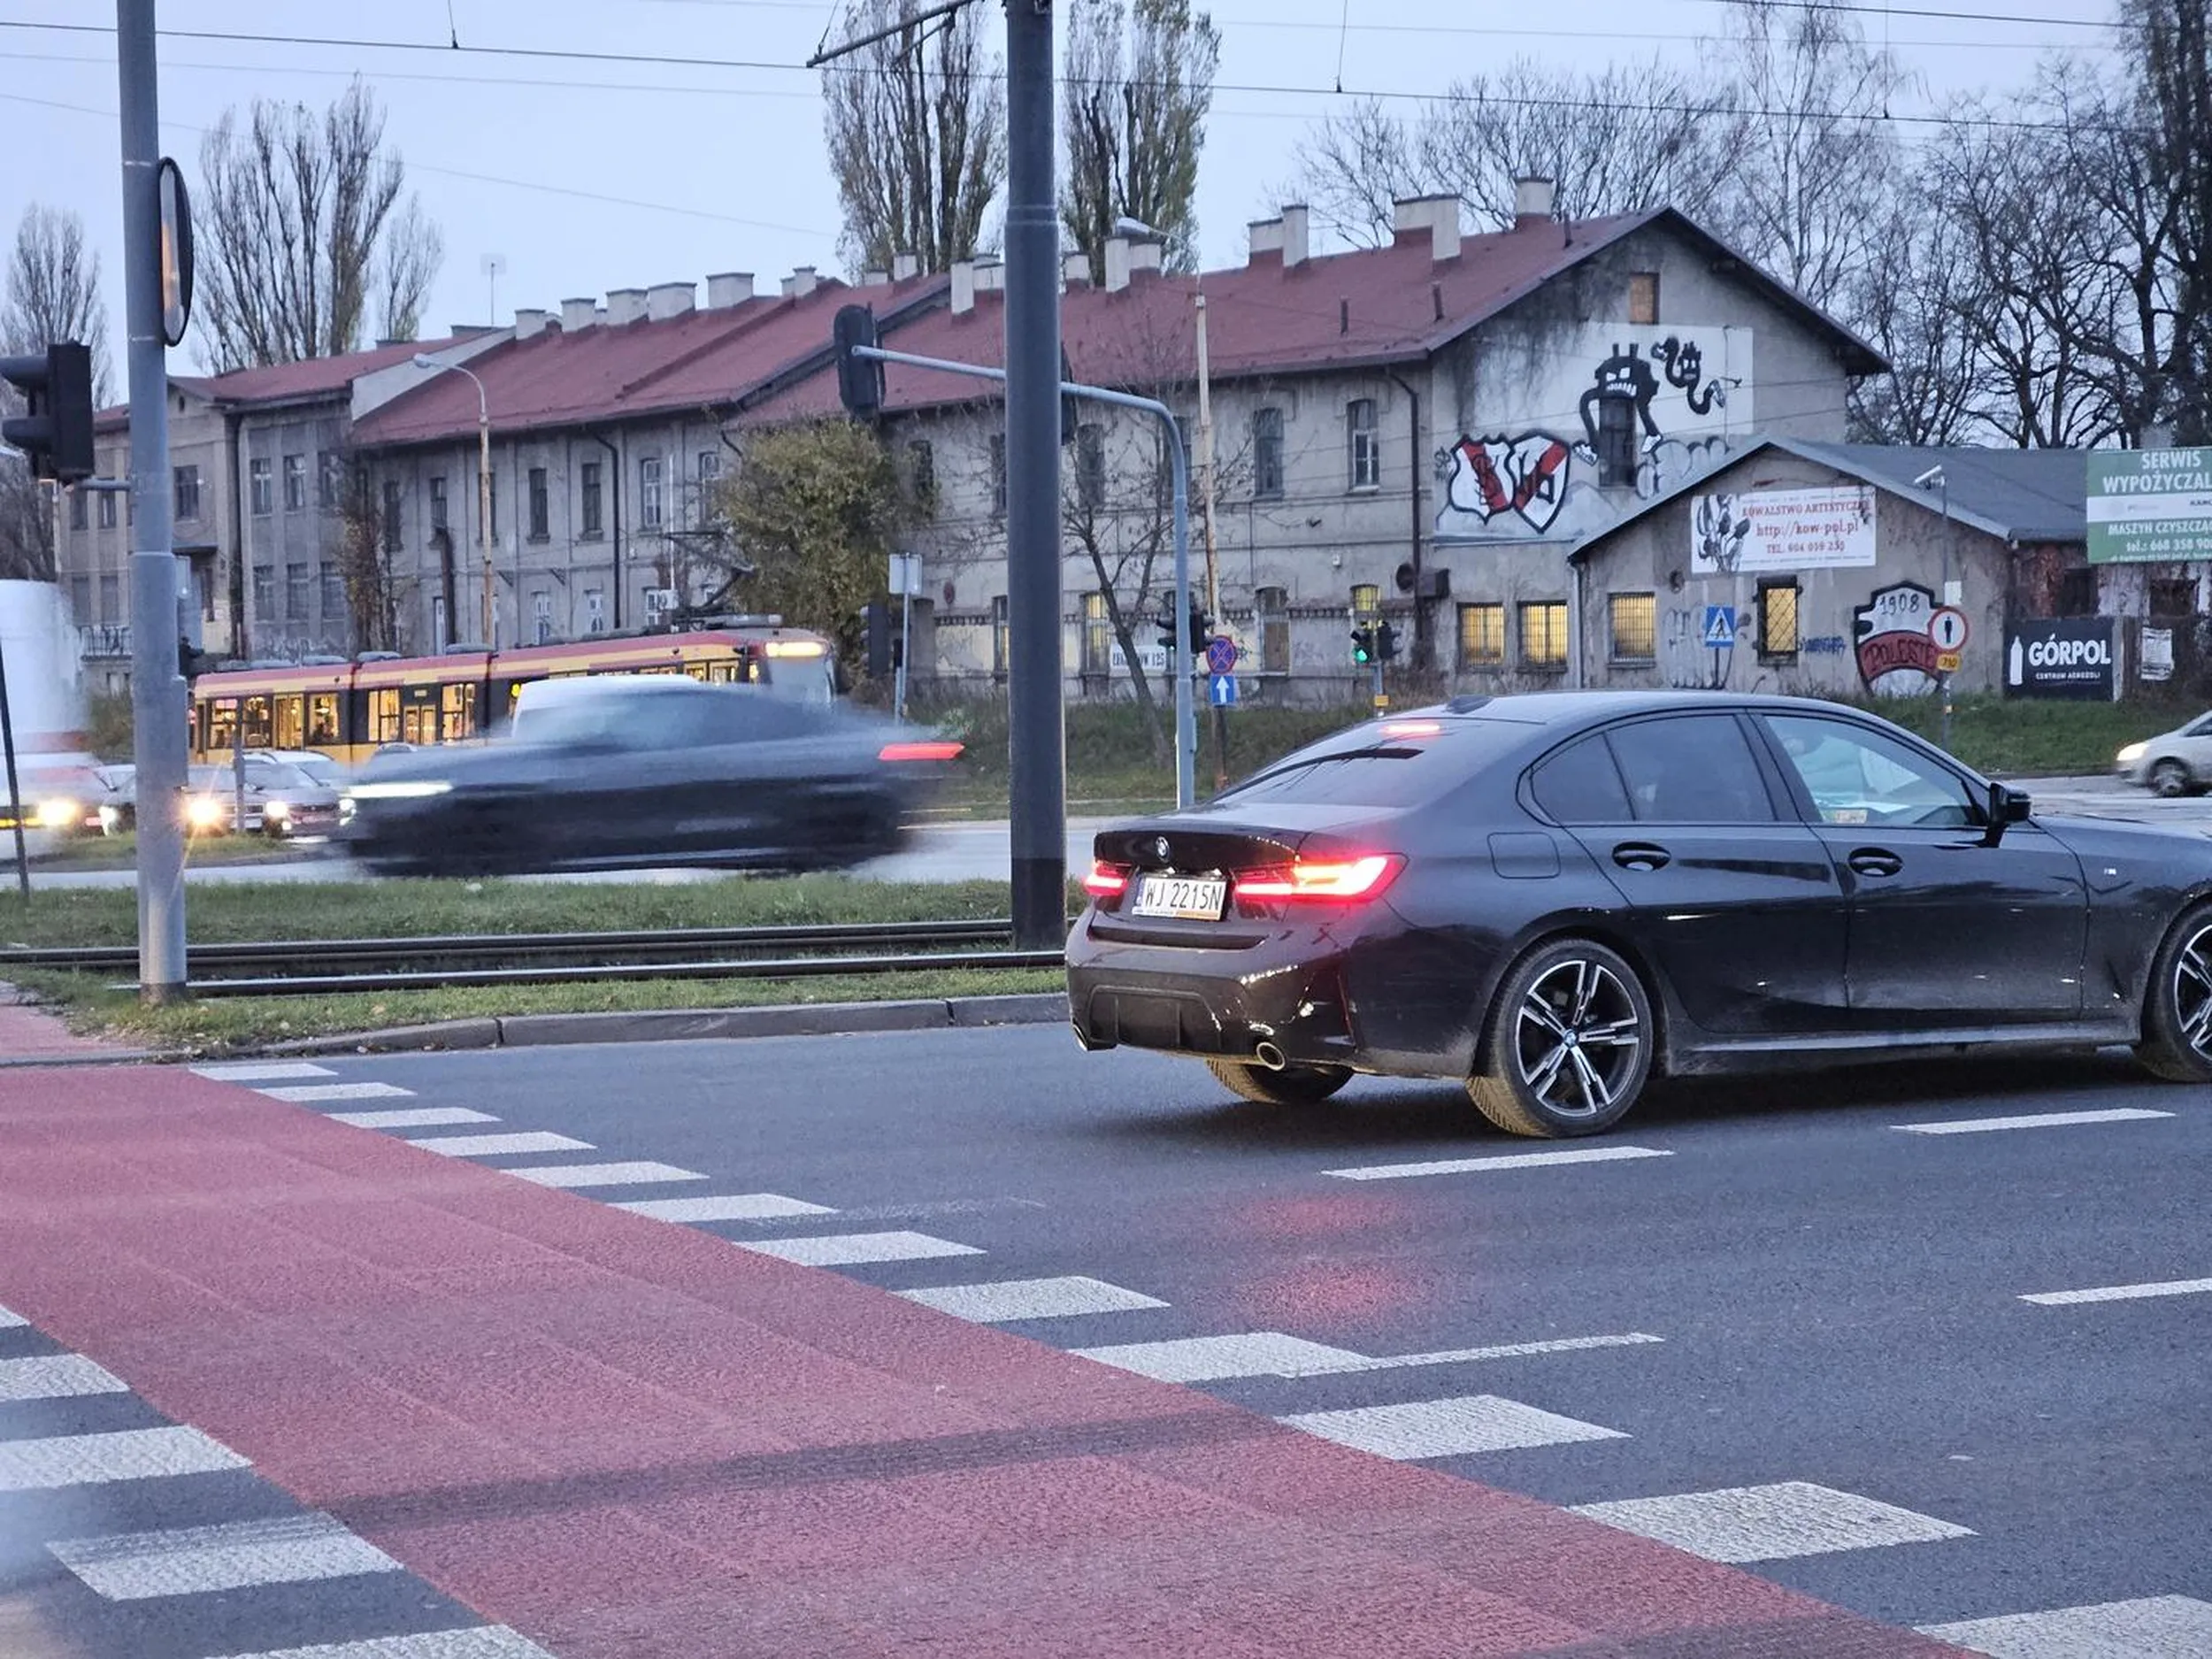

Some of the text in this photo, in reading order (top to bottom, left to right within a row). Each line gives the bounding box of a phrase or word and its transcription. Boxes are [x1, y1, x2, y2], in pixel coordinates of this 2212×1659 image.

[2141, 450, 2200, 469] SERWIS
[1742, 502, 1802, 518] KOWALSTWO
[2108, 522, 2153, 535] MASZYN
[1879, 593, 1920, 616] 1908
[2028, 633, 2112, 666] GÓRPOL
[2035, 672, 2066, 680] CENTRUM
[1145, 881, 1223, 911] WJ 2215N
